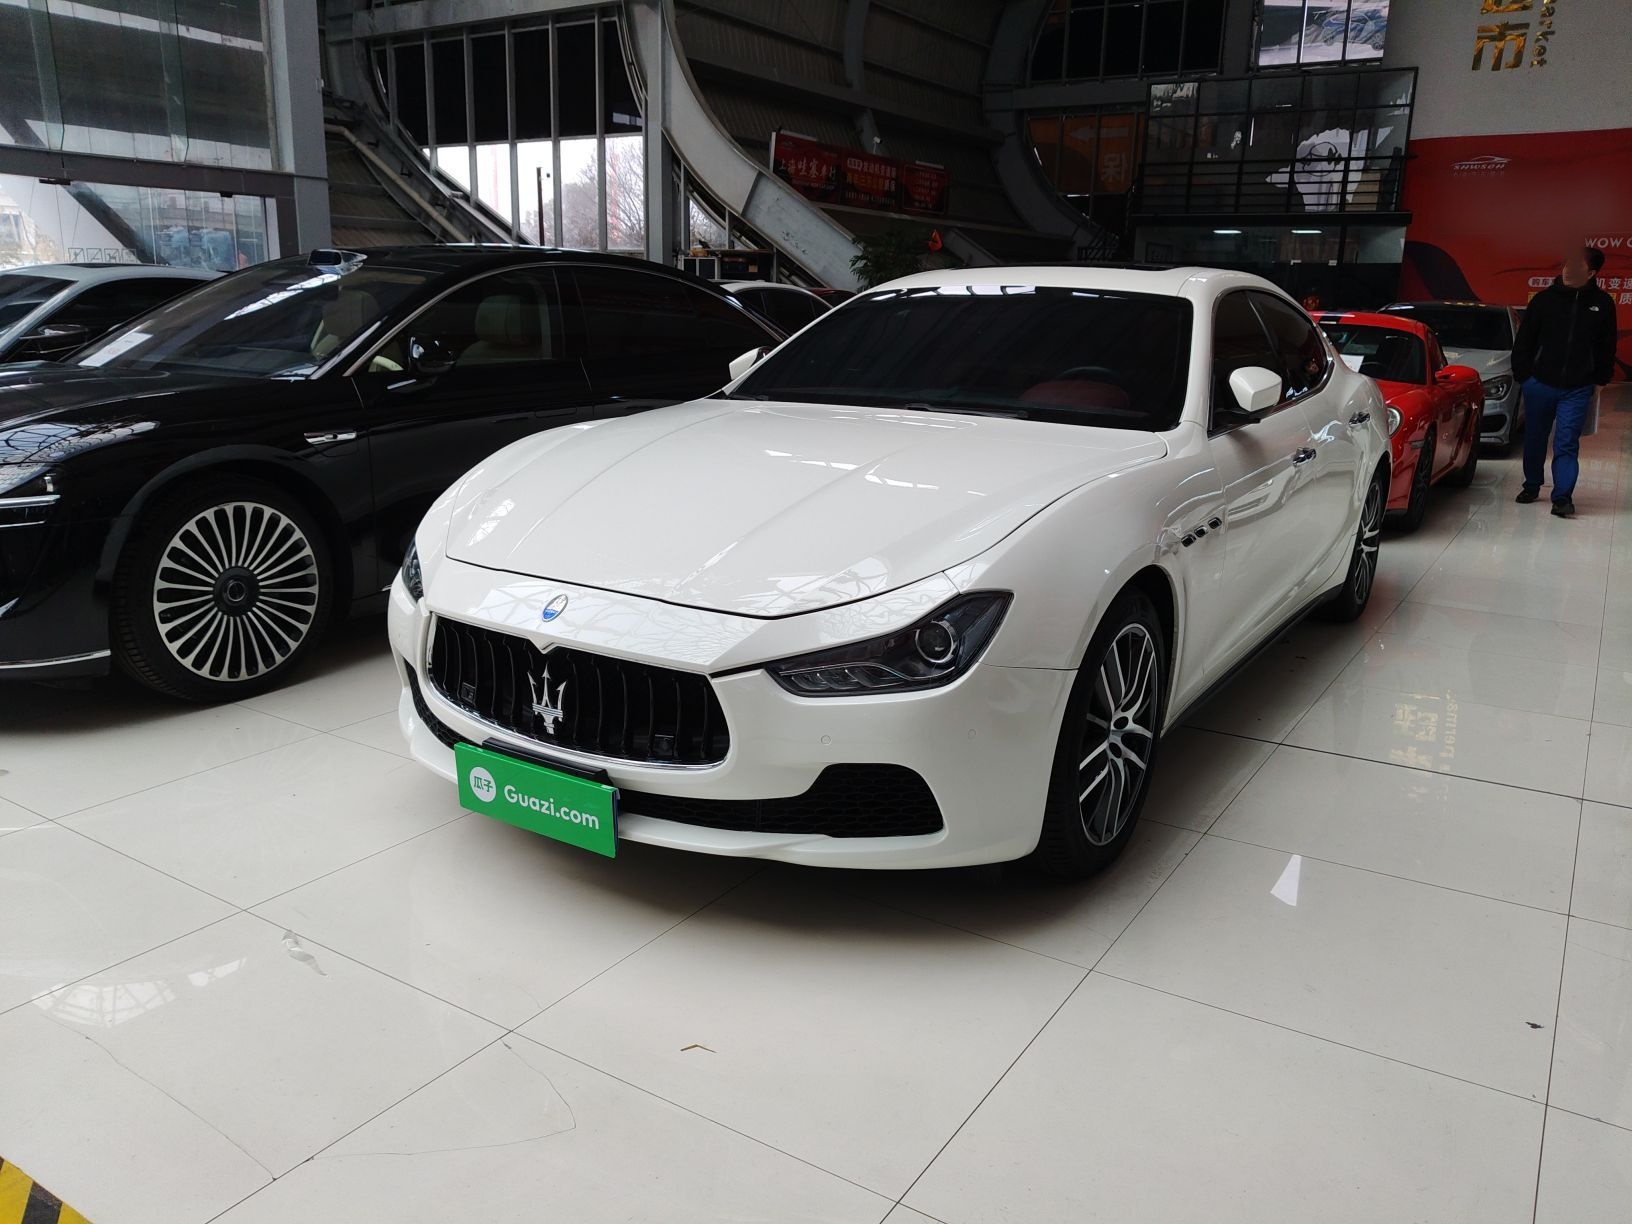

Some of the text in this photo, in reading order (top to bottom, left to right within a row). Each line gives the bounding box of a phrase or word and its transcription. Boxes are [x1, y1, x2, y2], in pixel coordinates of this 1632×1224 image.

[1585, 237, 1624, 248] WOW
[473, 776, 493, 793] 瓜子
[503, 784, 600, 830] Guazi.com
